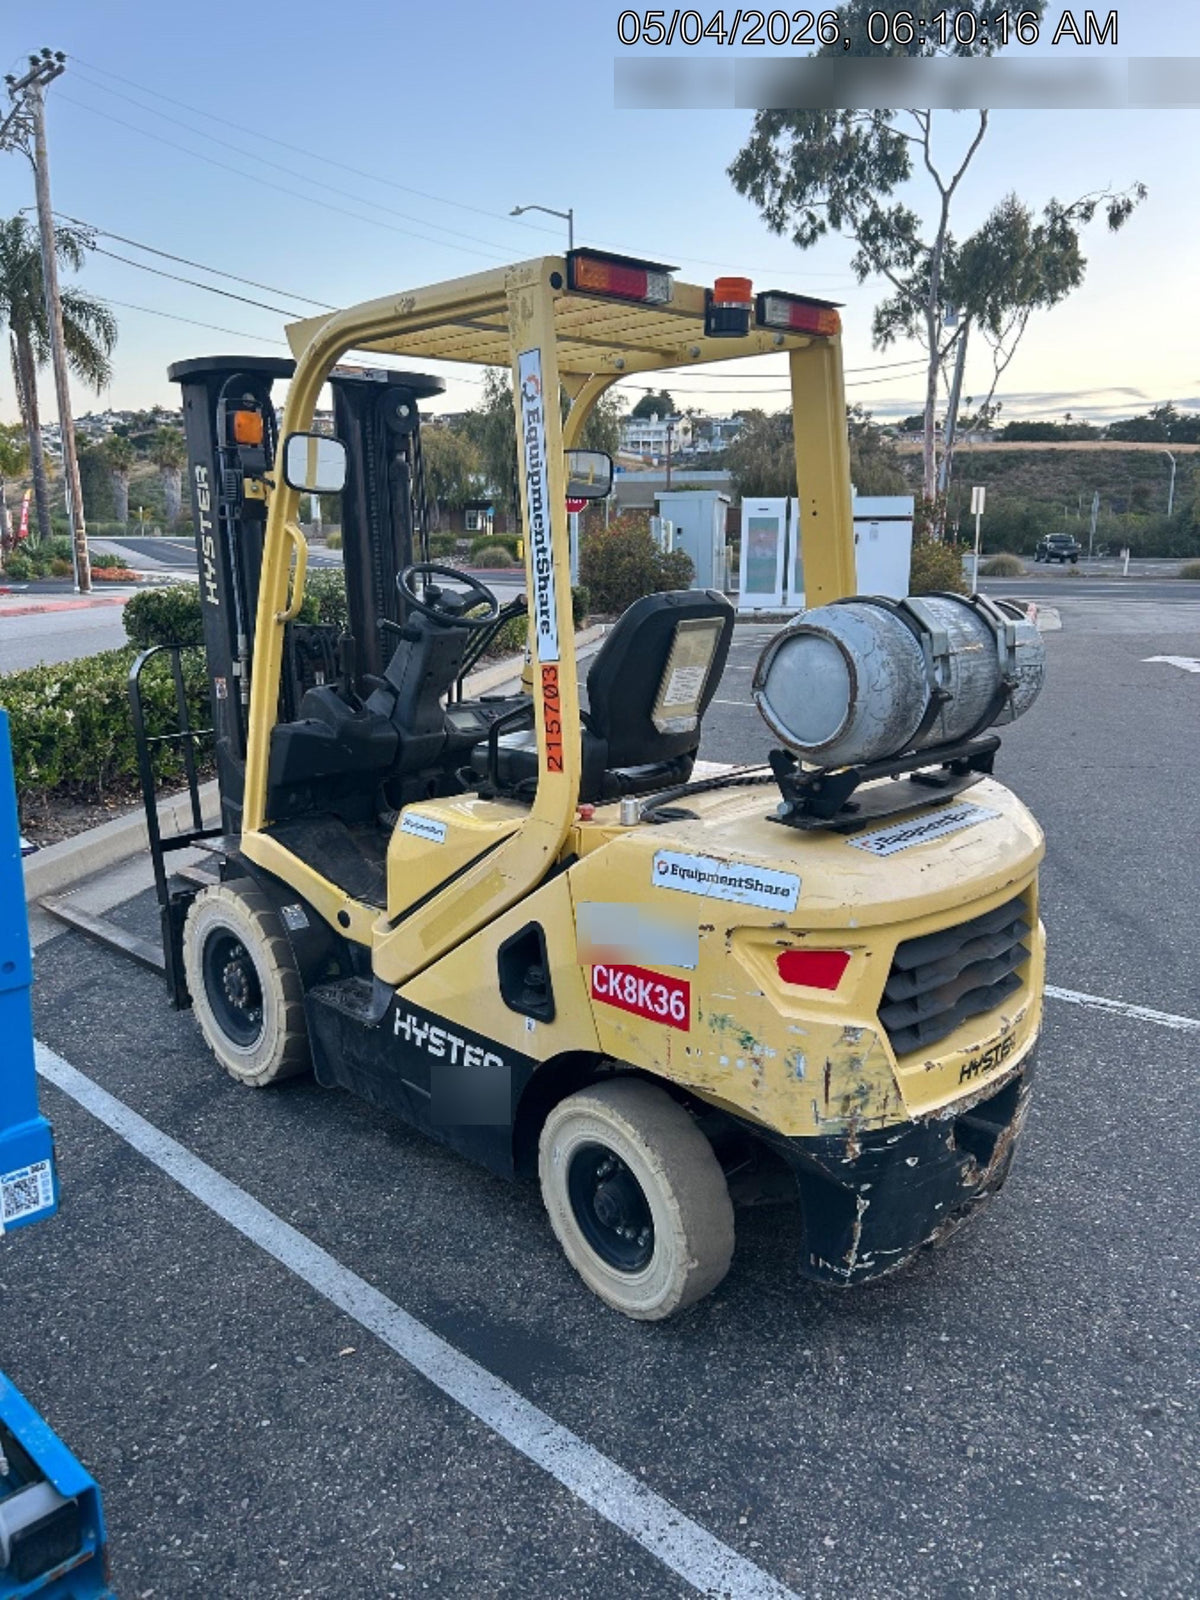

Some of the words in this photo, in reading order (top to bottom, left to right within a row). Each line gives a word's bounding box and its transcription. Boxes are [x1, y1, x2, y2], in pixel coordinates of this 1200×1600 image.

[194, 464, 220, 606] HYSTER
[525, 407, 552, 635] EquipmentShare
[542, 665, 562, 771] 215703
[669, 862, 791, 898] EquipmentShare
[592, 964, 686, 1021] CK8K36
